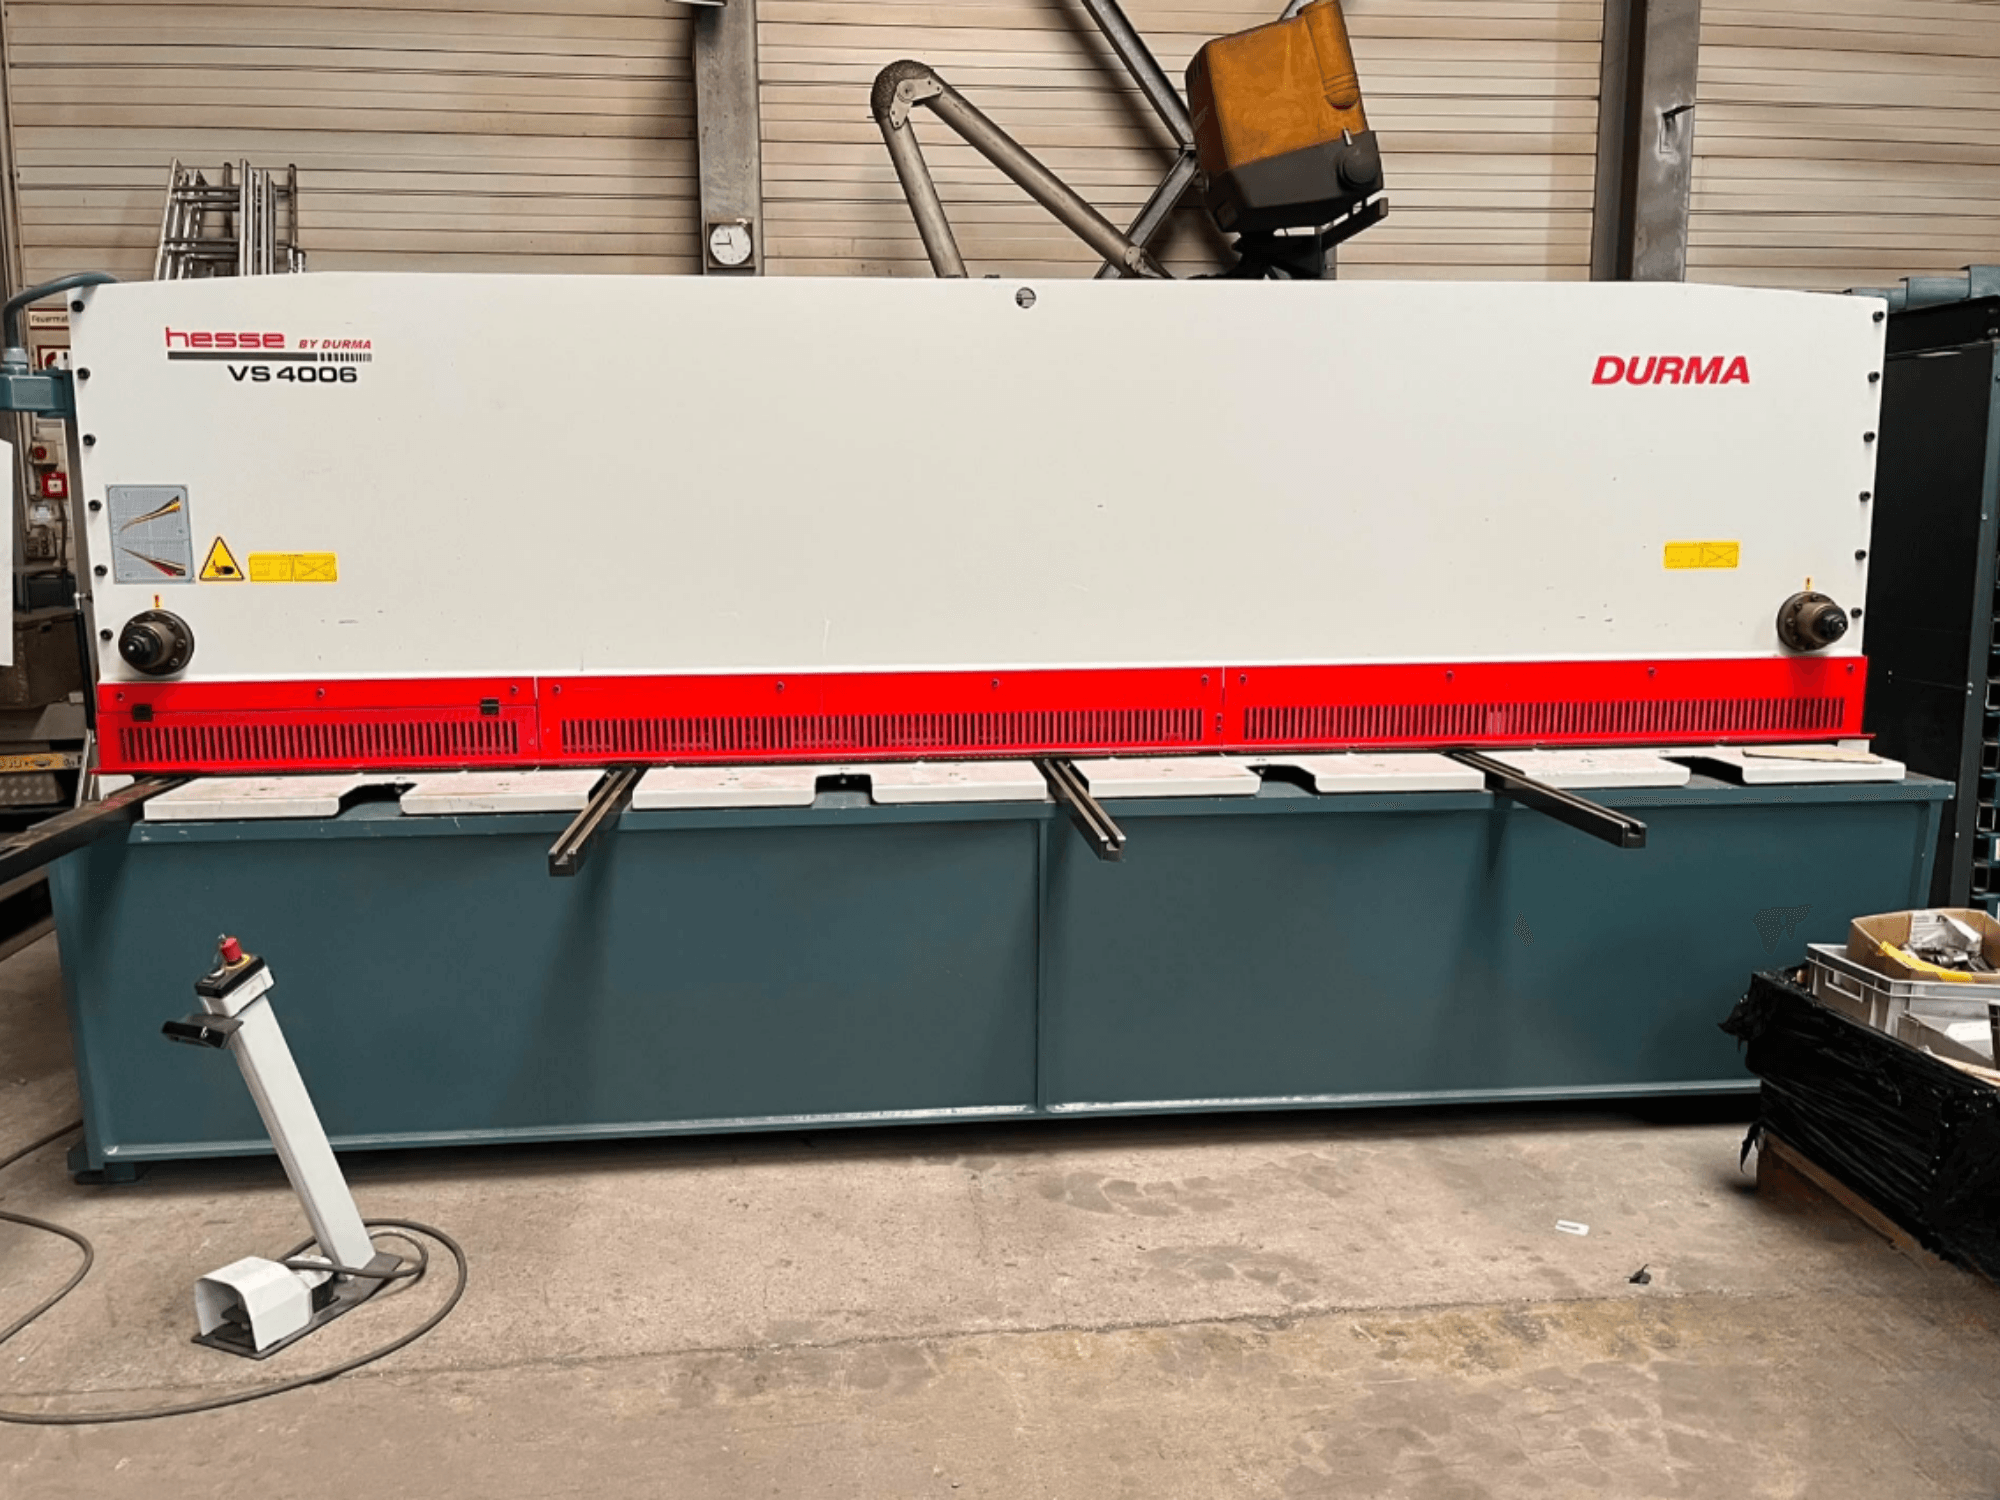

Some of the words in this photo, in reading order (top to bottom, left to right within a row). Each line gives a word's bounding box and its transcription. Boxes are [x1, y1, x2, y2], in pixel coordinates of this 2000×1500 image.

[165, 326, 285, 348] hesse
[298, 339, 318, 349] BY
[321, 339, 372, 349] DURMA
[227, 365, 271, 382] VS
[276, 365, 358, 383] 4006
[1591, 355, 1750, 385] DURMA
